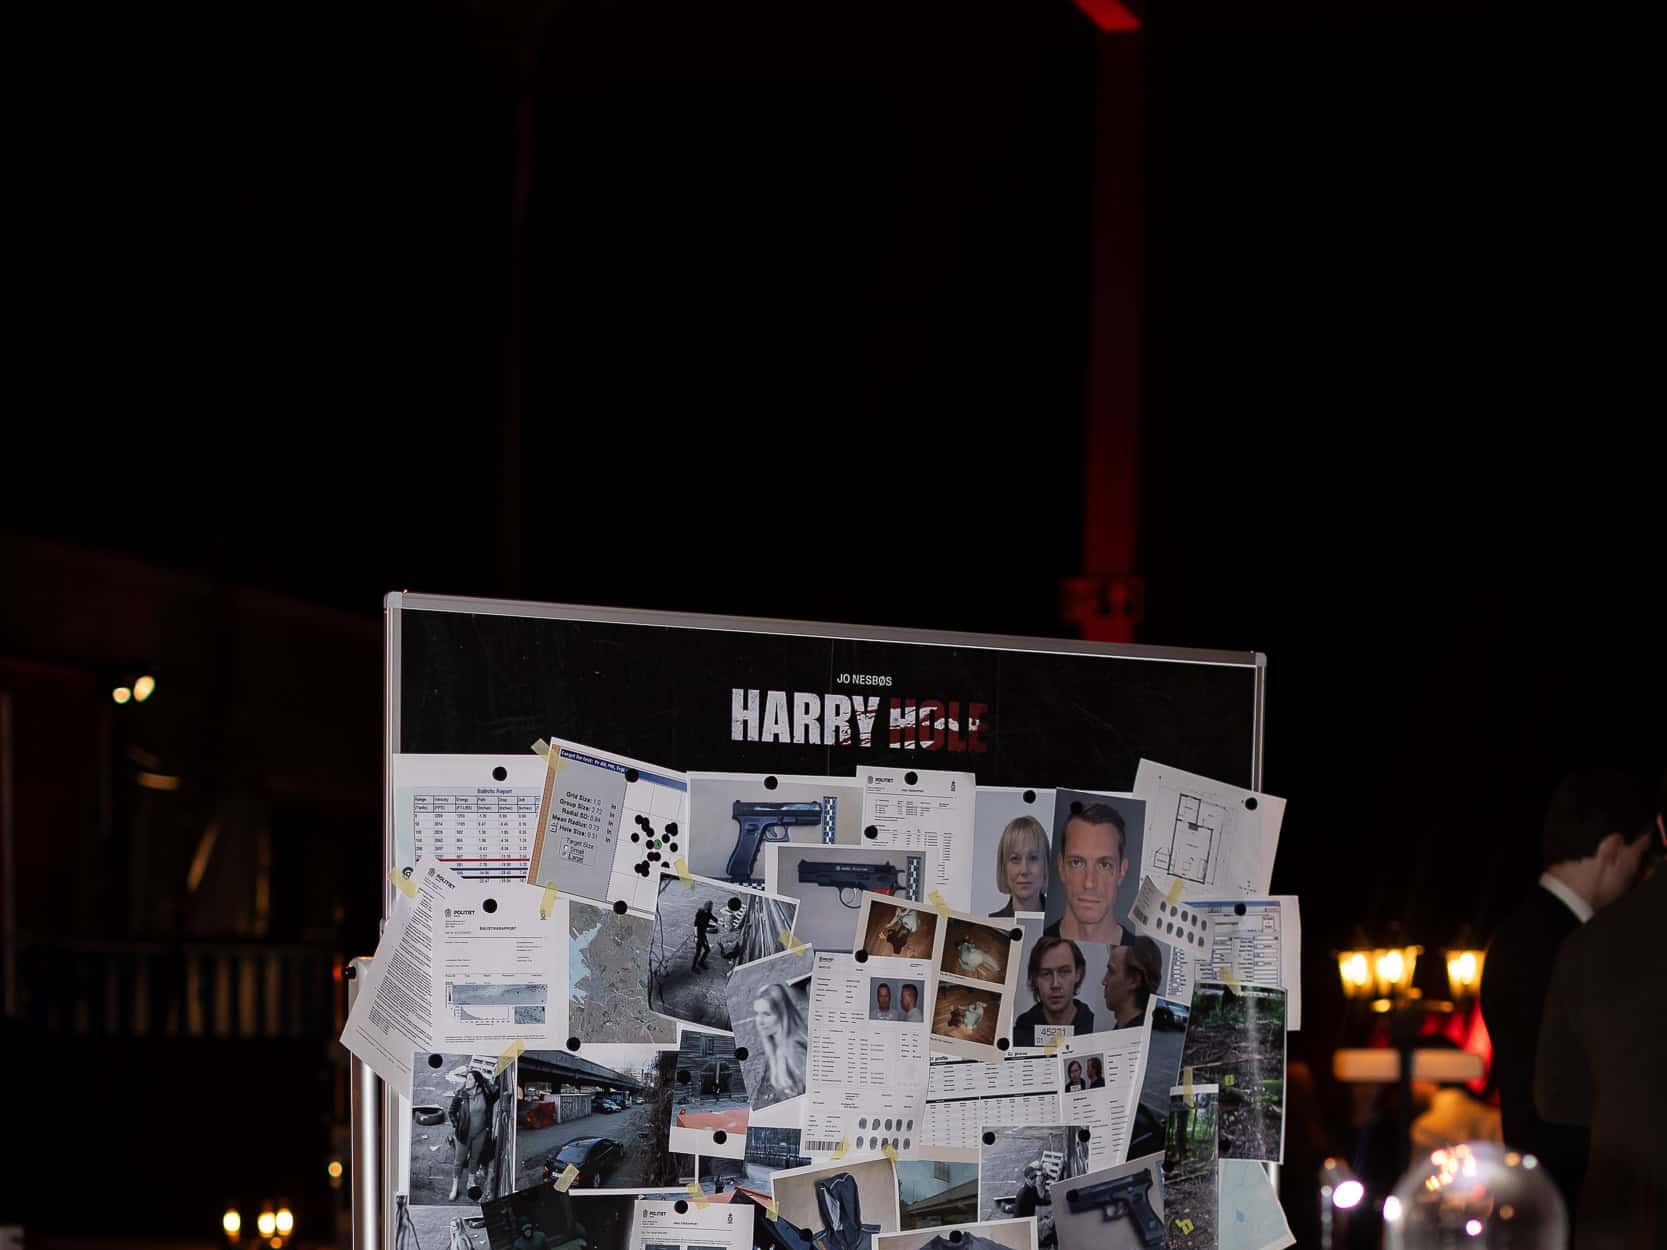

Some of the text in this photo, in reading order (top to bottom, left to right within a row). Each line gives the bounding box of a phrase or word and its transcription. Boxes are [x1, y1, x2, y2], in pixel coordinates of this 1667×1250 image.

[836, 673, 892, 686] JO NESBØS
[731, 687, 989, 752] HARRY HOLE
